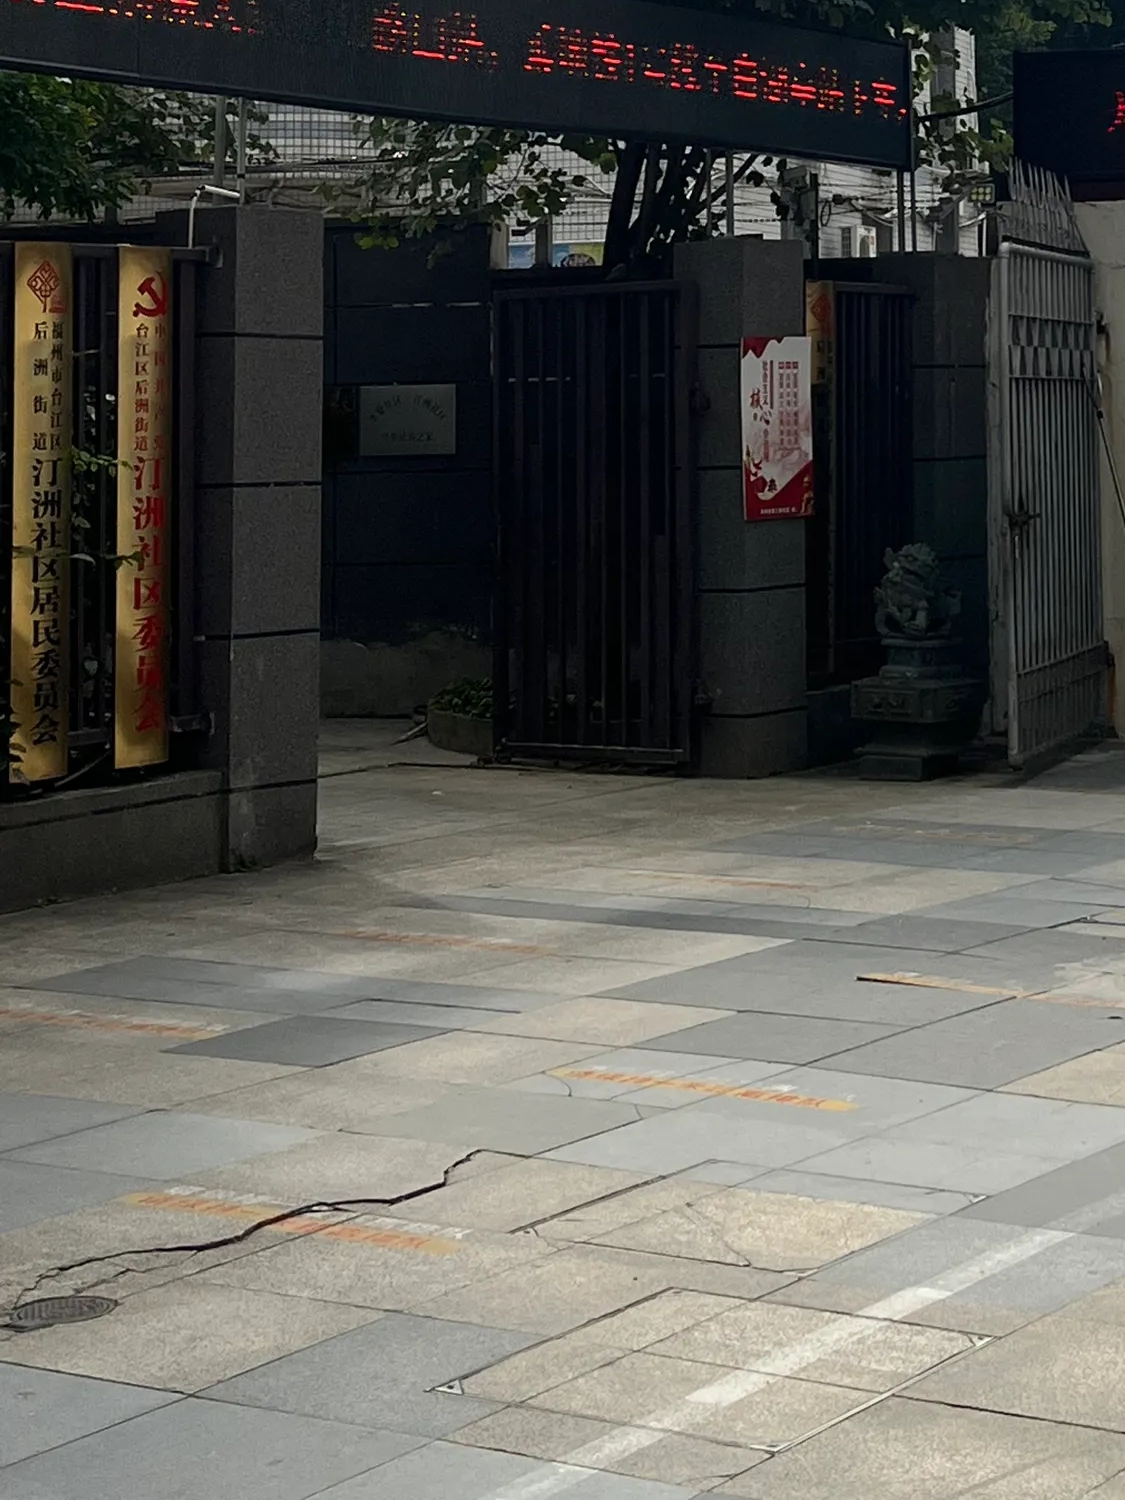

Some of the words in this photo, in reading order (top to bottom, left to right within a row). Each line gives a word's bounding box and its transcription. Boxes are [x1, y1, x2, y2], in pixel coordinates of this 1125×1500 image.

[32, 321, 49, 451] 后洲街道
[133, 323, 150, 452] 台江区后洲街道
[30, 456, 64, 745] 汀洲社区居民委员会
